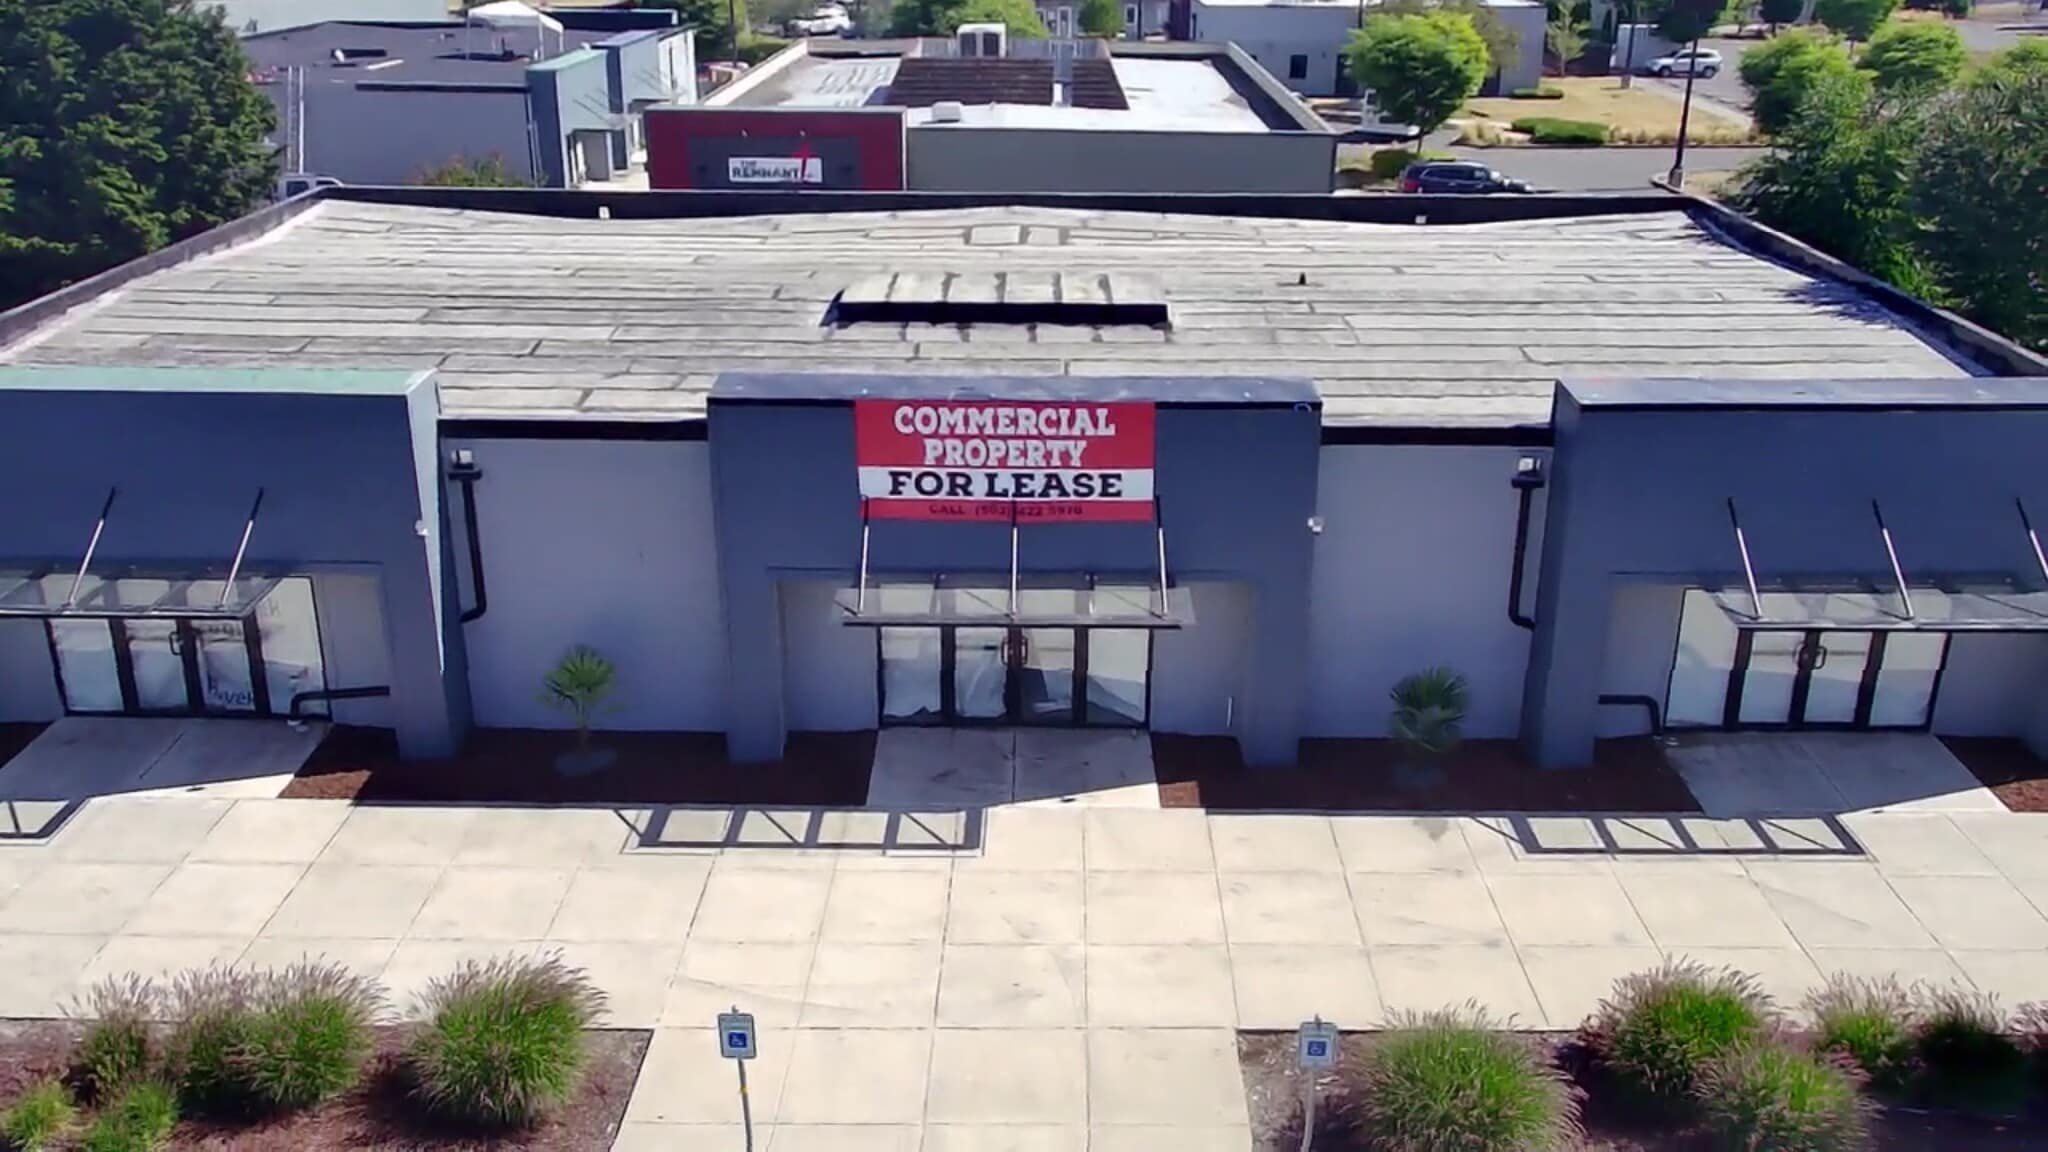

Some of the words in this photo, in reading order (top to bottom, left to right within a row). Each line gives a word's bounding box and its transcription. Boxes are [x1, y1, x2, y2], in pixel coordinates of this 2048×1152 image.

[732, 167, 799, 179] REMNANT
[894, 405, 1116, 436] COMMERCIAL
[923, 438, 1088, 467] PROPERTY
[888, 471, 974, 497] FOR
[984, 472, 1123, 498] LEASE
[929, 504, 965, 515] CALL
